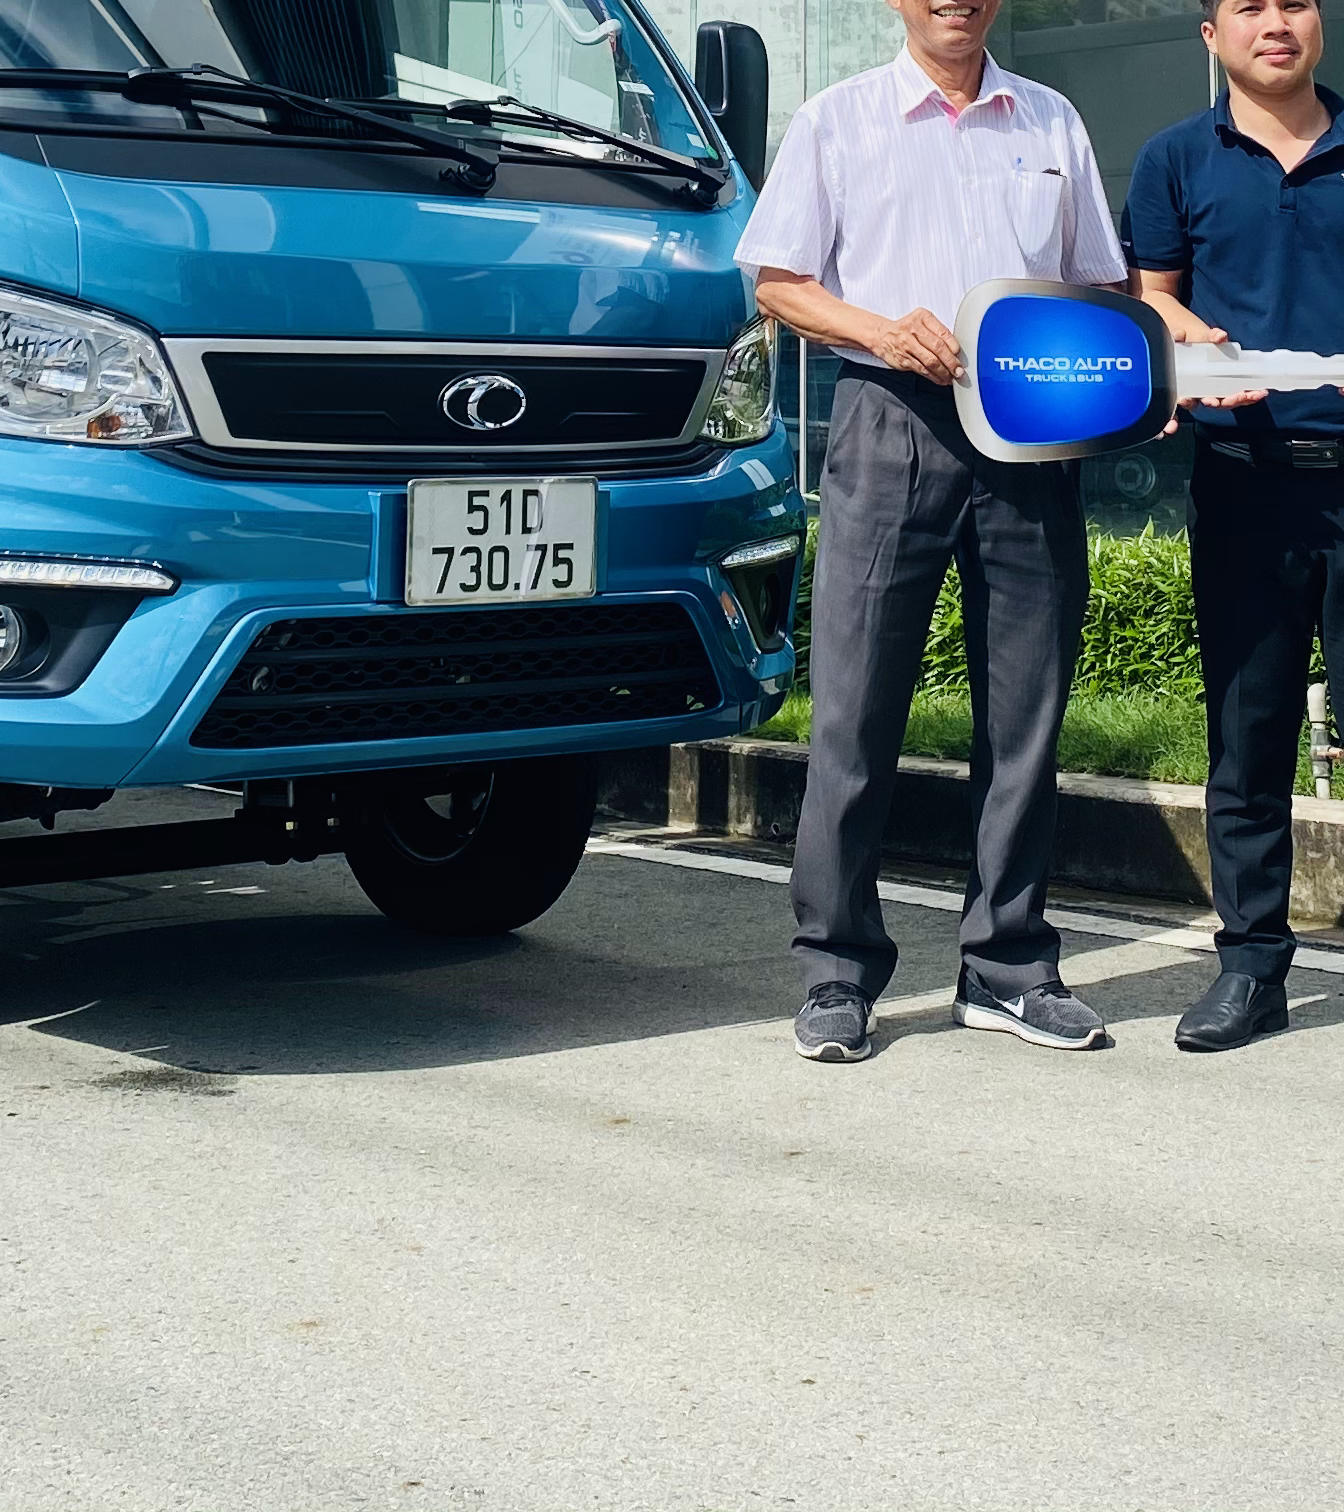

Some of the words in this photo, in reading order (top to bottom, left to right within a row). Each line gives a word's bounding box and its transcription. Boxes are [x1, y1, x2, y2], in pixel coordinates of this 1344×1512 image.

[994, 357, 1071, 371] THACO
[1072, 357, 1133, 371] AUTO
[466, 489, 543, 535] 51D
[432, 543, 574, 594] 730.75
